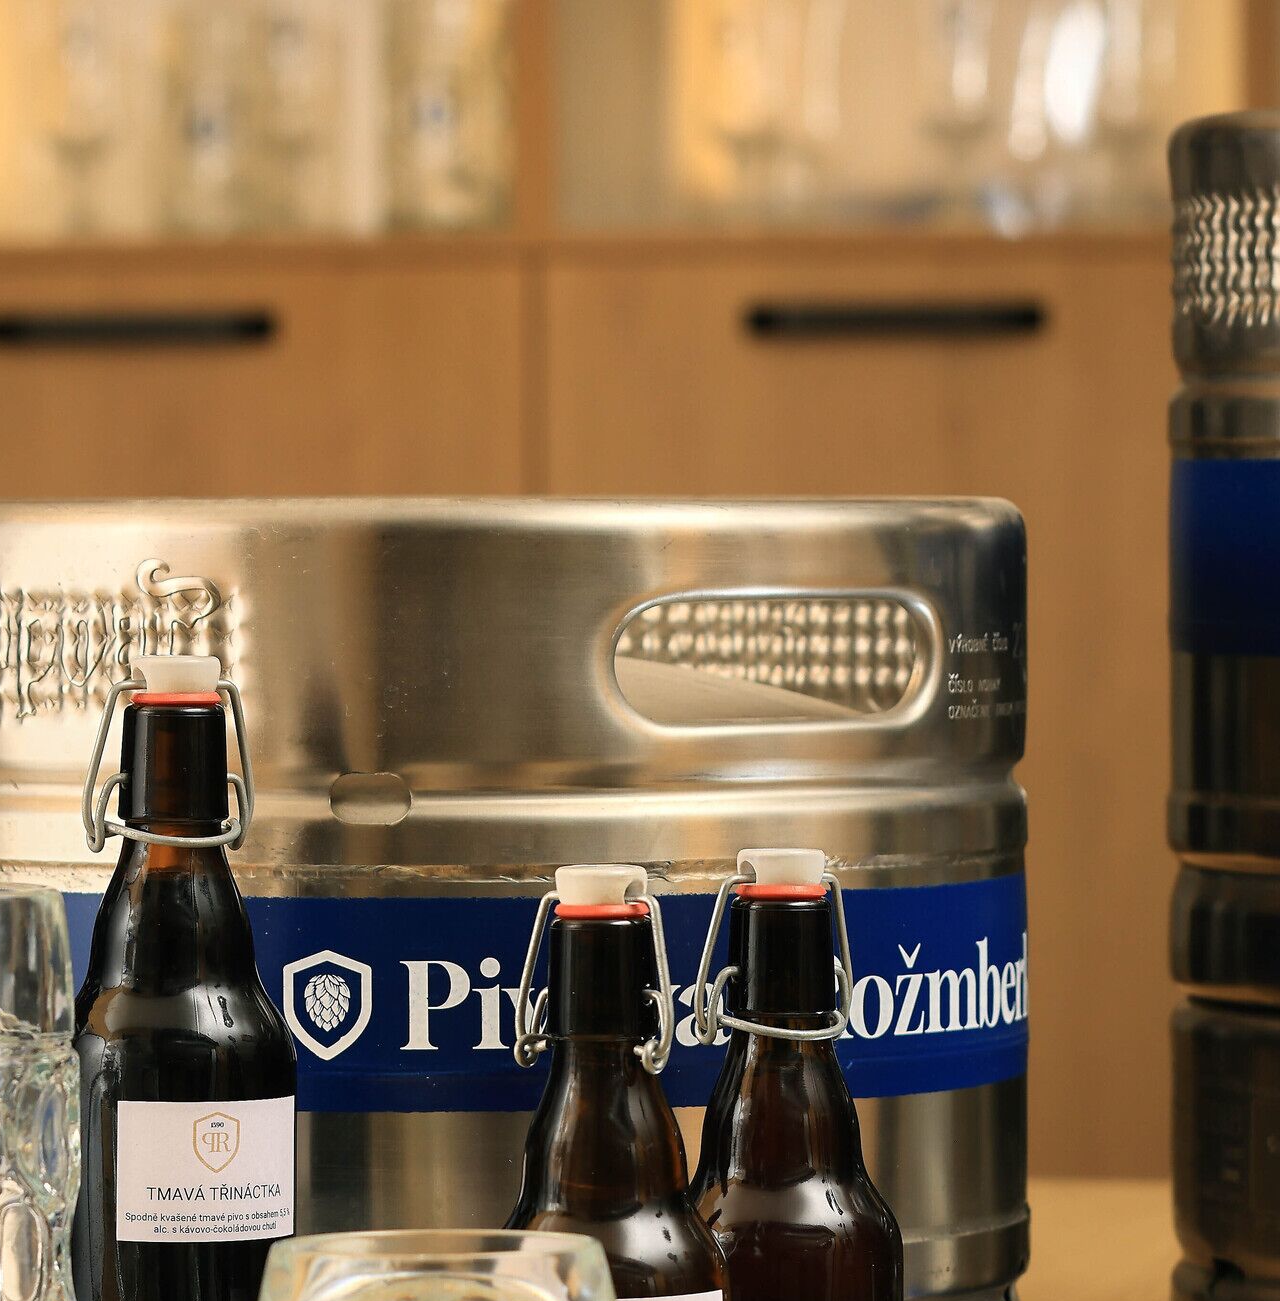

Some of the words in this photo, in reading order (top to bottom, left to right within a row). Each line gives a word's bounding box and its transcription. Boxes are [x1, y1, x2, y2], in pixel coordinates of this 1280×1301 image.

[146, 1184, 206, 1201] TMAVÁ
[209, 1182, 282, 1201] TŘINÁCTKA
[125, 1212, 158, 1223] Spodně
[160, 1212, 197, 1222] kvašené
[199, 1212, 225, 1222] tmavé
[227, 1212, 244, 1223] pivo
[251, 1209, 279, 1220] obsahem
[153, 1225, 169, 1234] alc.
[179, 1223, 261, 1234] kávovo-čokoládovou
[262, 1221, 277, 1231] chutí
